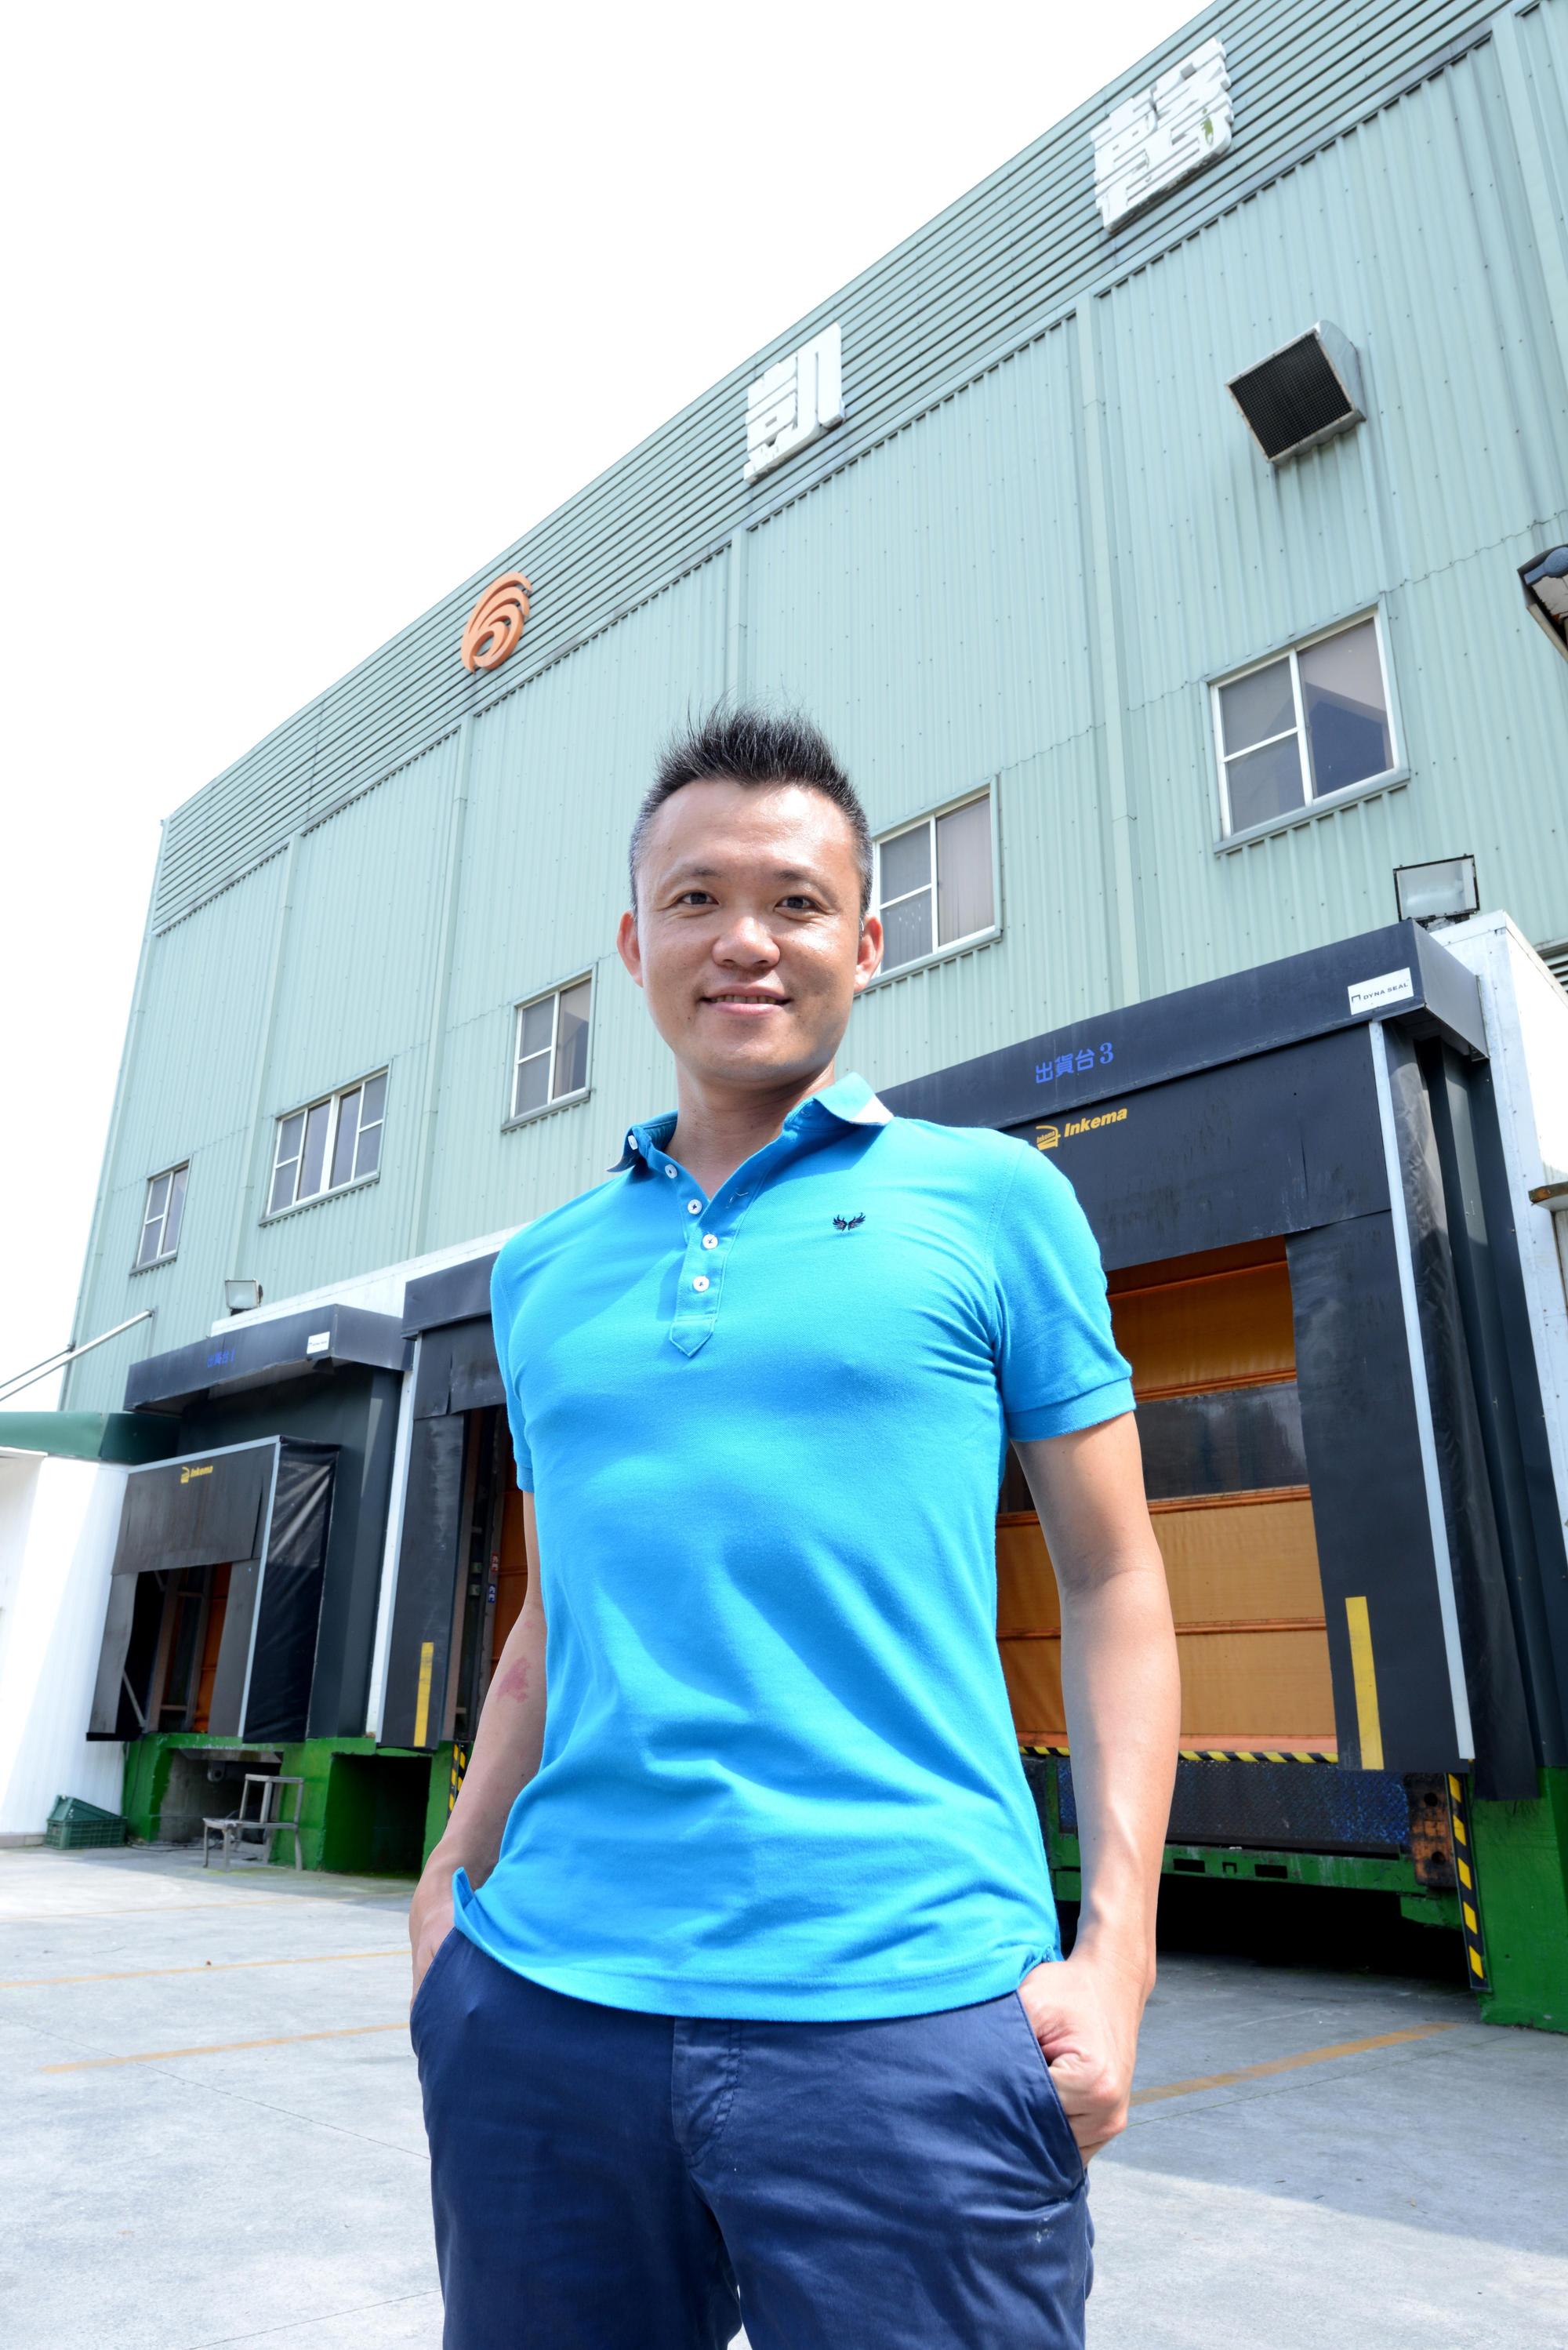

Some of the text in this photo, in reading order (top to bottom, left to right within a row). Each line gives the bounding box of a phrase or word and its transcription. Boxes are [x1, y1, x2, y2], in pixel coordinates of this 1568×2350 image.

[1363, 982, 1408, 1000] DYNA SEAL
[1064, 1107, 1127, 1137] Inkema
